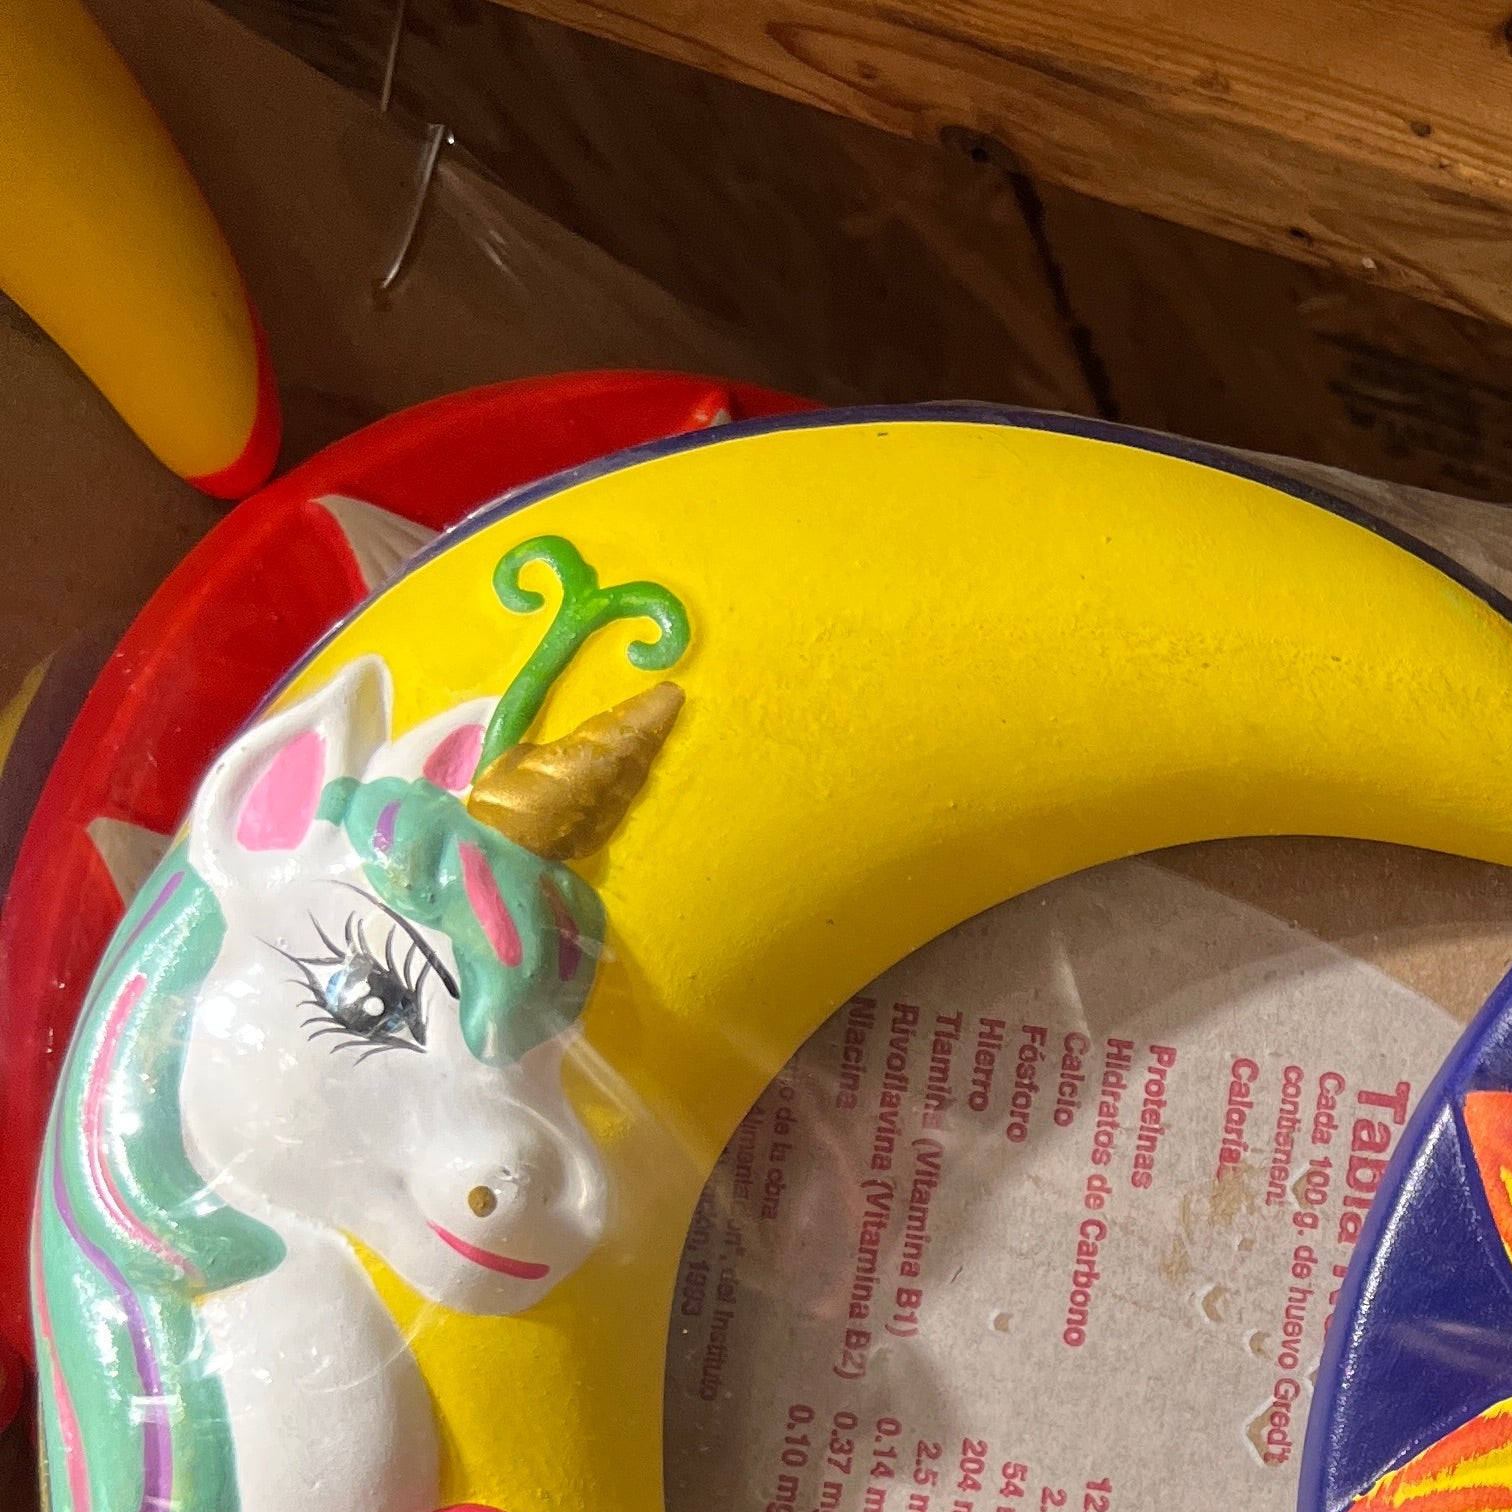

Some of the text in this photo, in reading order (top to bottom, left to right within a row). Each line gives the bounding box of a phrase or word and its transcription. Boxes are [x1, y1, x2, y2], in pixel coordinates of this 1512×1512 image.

[833, 994, 875, 1115] Niacina
[868, 1004, 918, 1172] Rivoflavina
[921, 1013, 962, 1128] Tiamina
[967, 1017, 1007, 1112] Hierro
[1005, 1024, 1048, 1143] Fósforo
[1052, 1032, 1088, 1128] Calcio
[1090, 1038, 1134, 1165] Hidratos
[1215, 1057, 1259, 1179] Caloría
[1311, 1071, 1345, 1144] Cada
[898, 1137, 943, 1278] (Vitamina
[1083, 1173, 1112, 1210] de
[1303, 1156, 1332, 1205] 100
[848, 1178, 893, 1319] (Vitamina
[1291, 1211, 1319, 1235] g.
[1062, 1218, 1107, 1347] Carbono
[1290, 1244, 1317, 1279] de
[886, 1286, 922, 1336] B1)
[1276, 1286, 1312, 1370] huevo
[832, 1326, 872, 1380] B2)
[780, 1403, 815, 1468] 0.10
[827, 1412, 857, 1474] 0.37
[869, 1417, 901, 1478] 0.14
[912, 1440, 941, 1486] 2.5
[957, 1438, 987, 1491] 204
[999, 1462, 1027, 1497] 54
